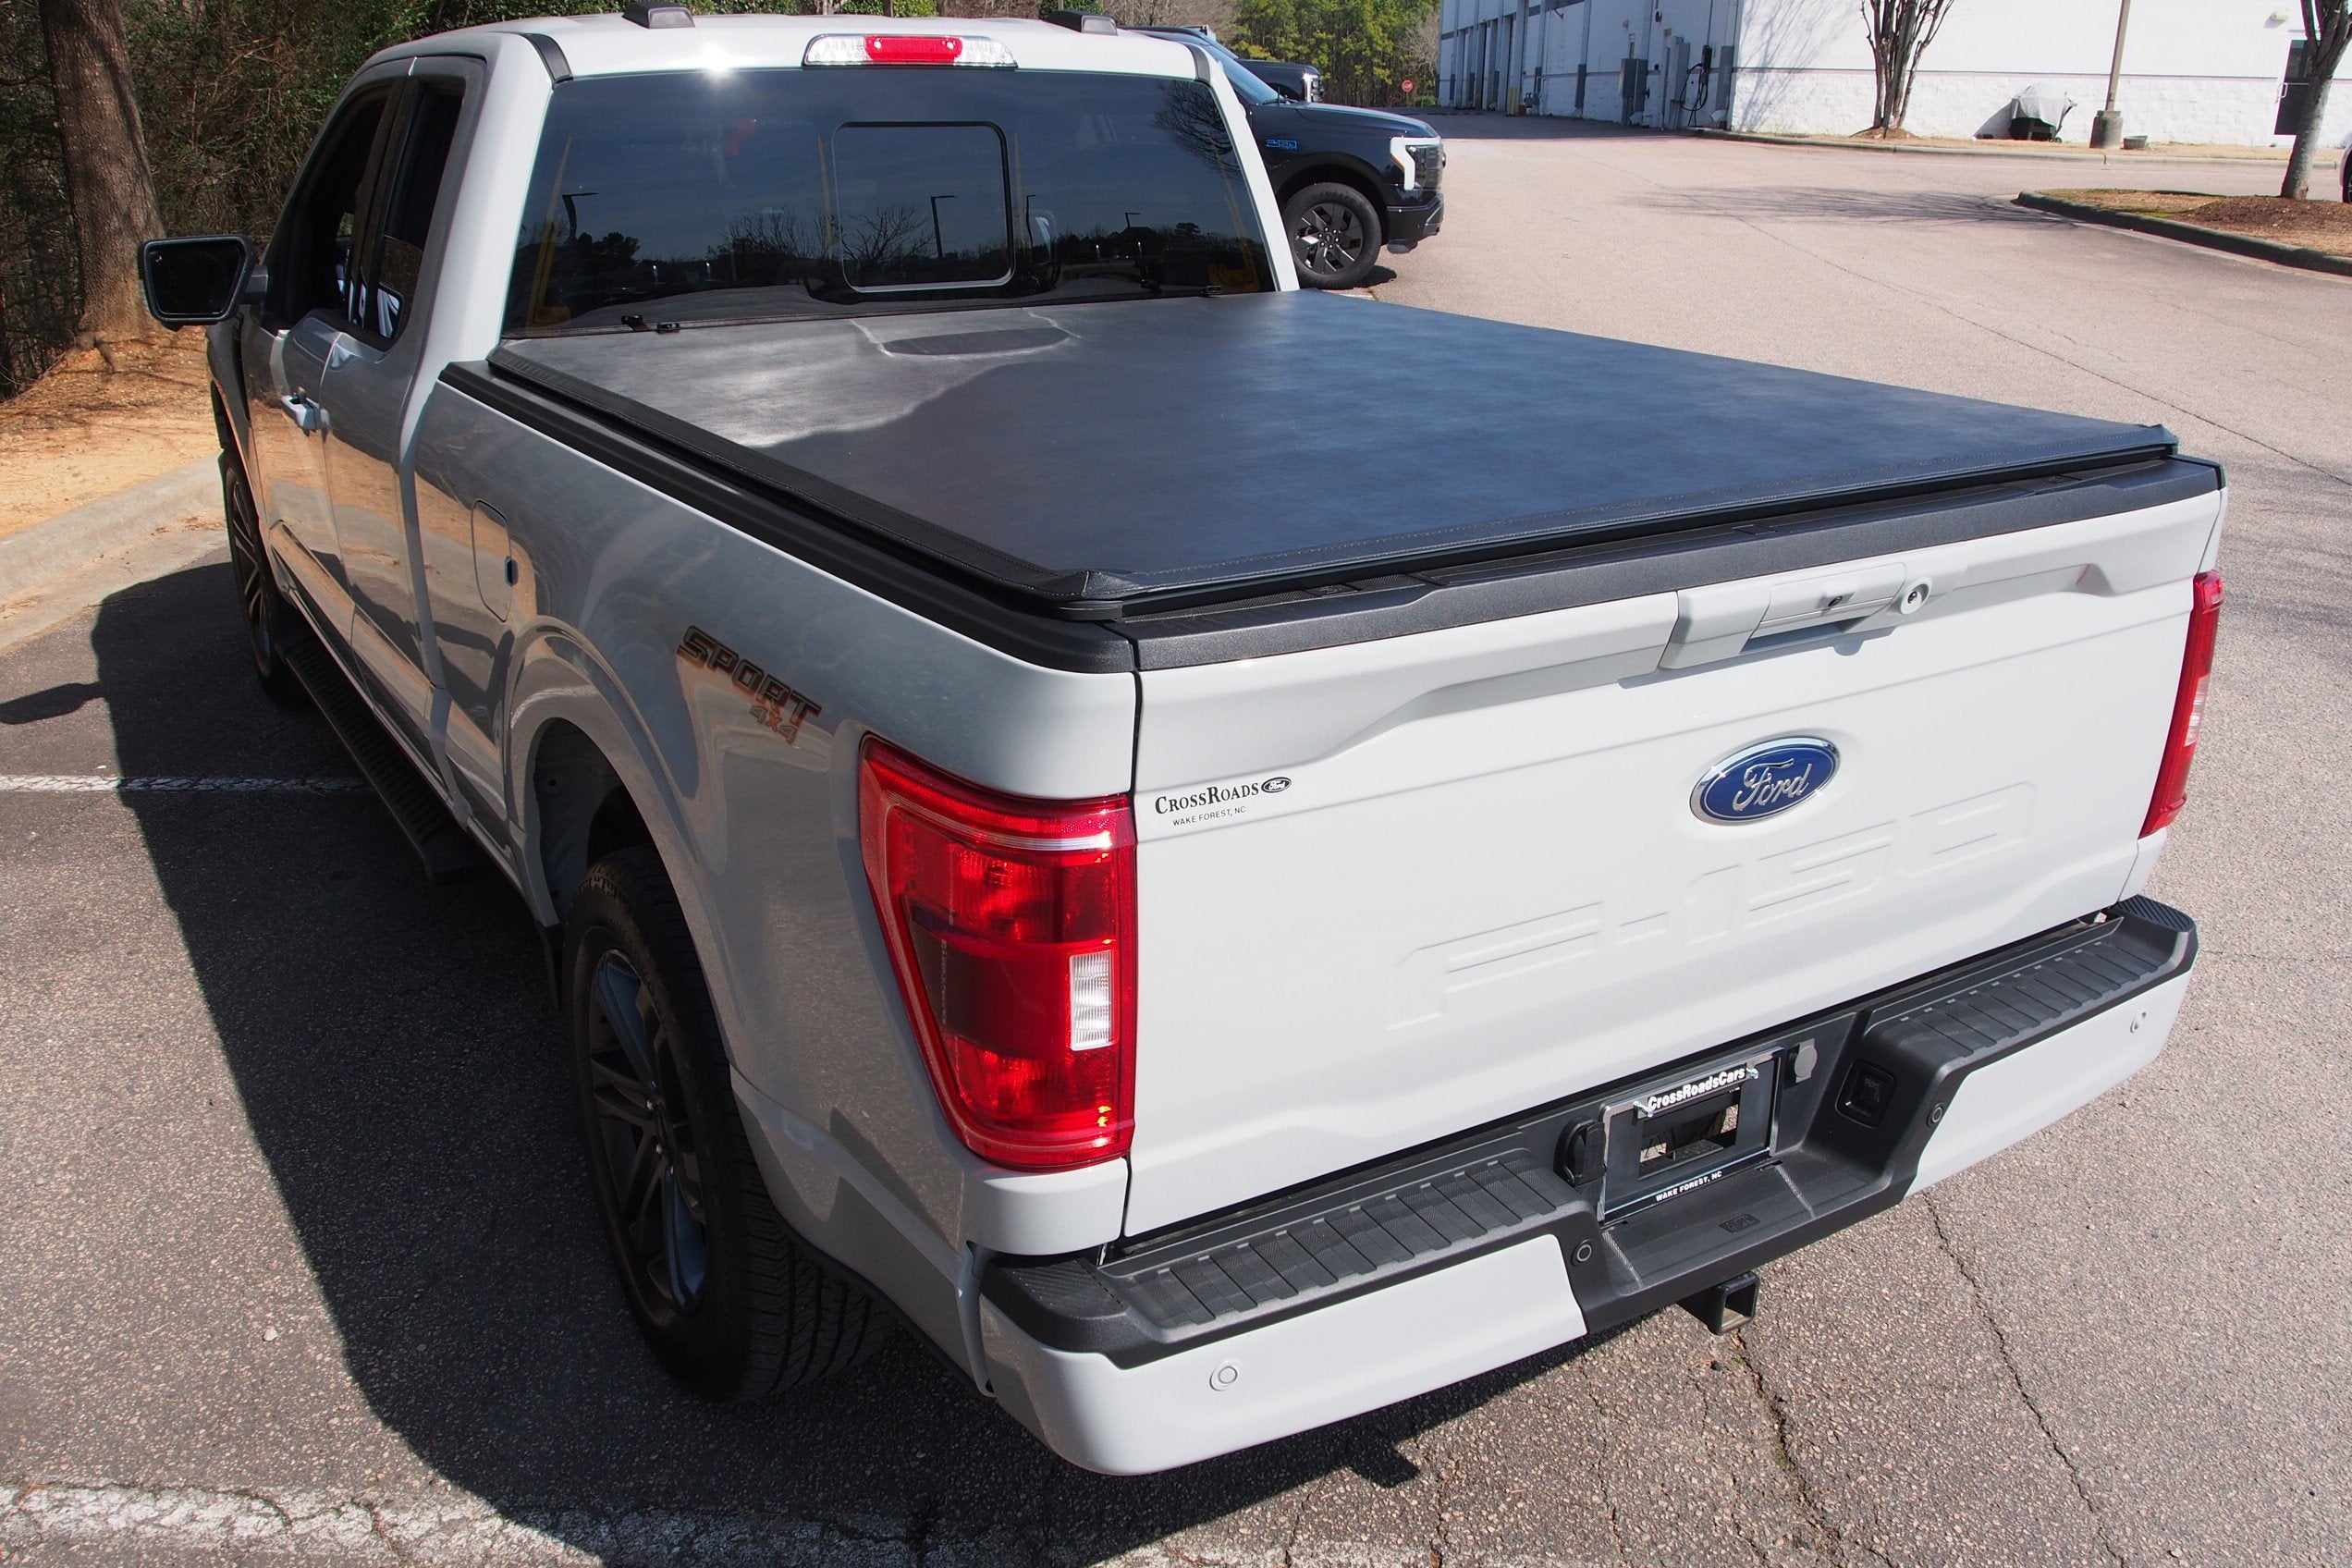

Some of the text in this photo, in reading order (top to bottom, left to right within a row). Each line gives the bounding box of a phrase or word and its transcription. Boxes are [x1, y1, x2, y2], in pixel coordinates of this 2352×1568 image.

[677, 625, 822, 728] SPORT
[1733, 758, 1812, 811] Ford
[1172, 806, 1246, 826] WAKE FOREST, NC
[1386, 780, 2037, 1029] F-150
[1648, 1068, 1746, 1112] CrossRoadsCars
[1656, 1170, 1722, 1202] WAKE FOREST, NC
